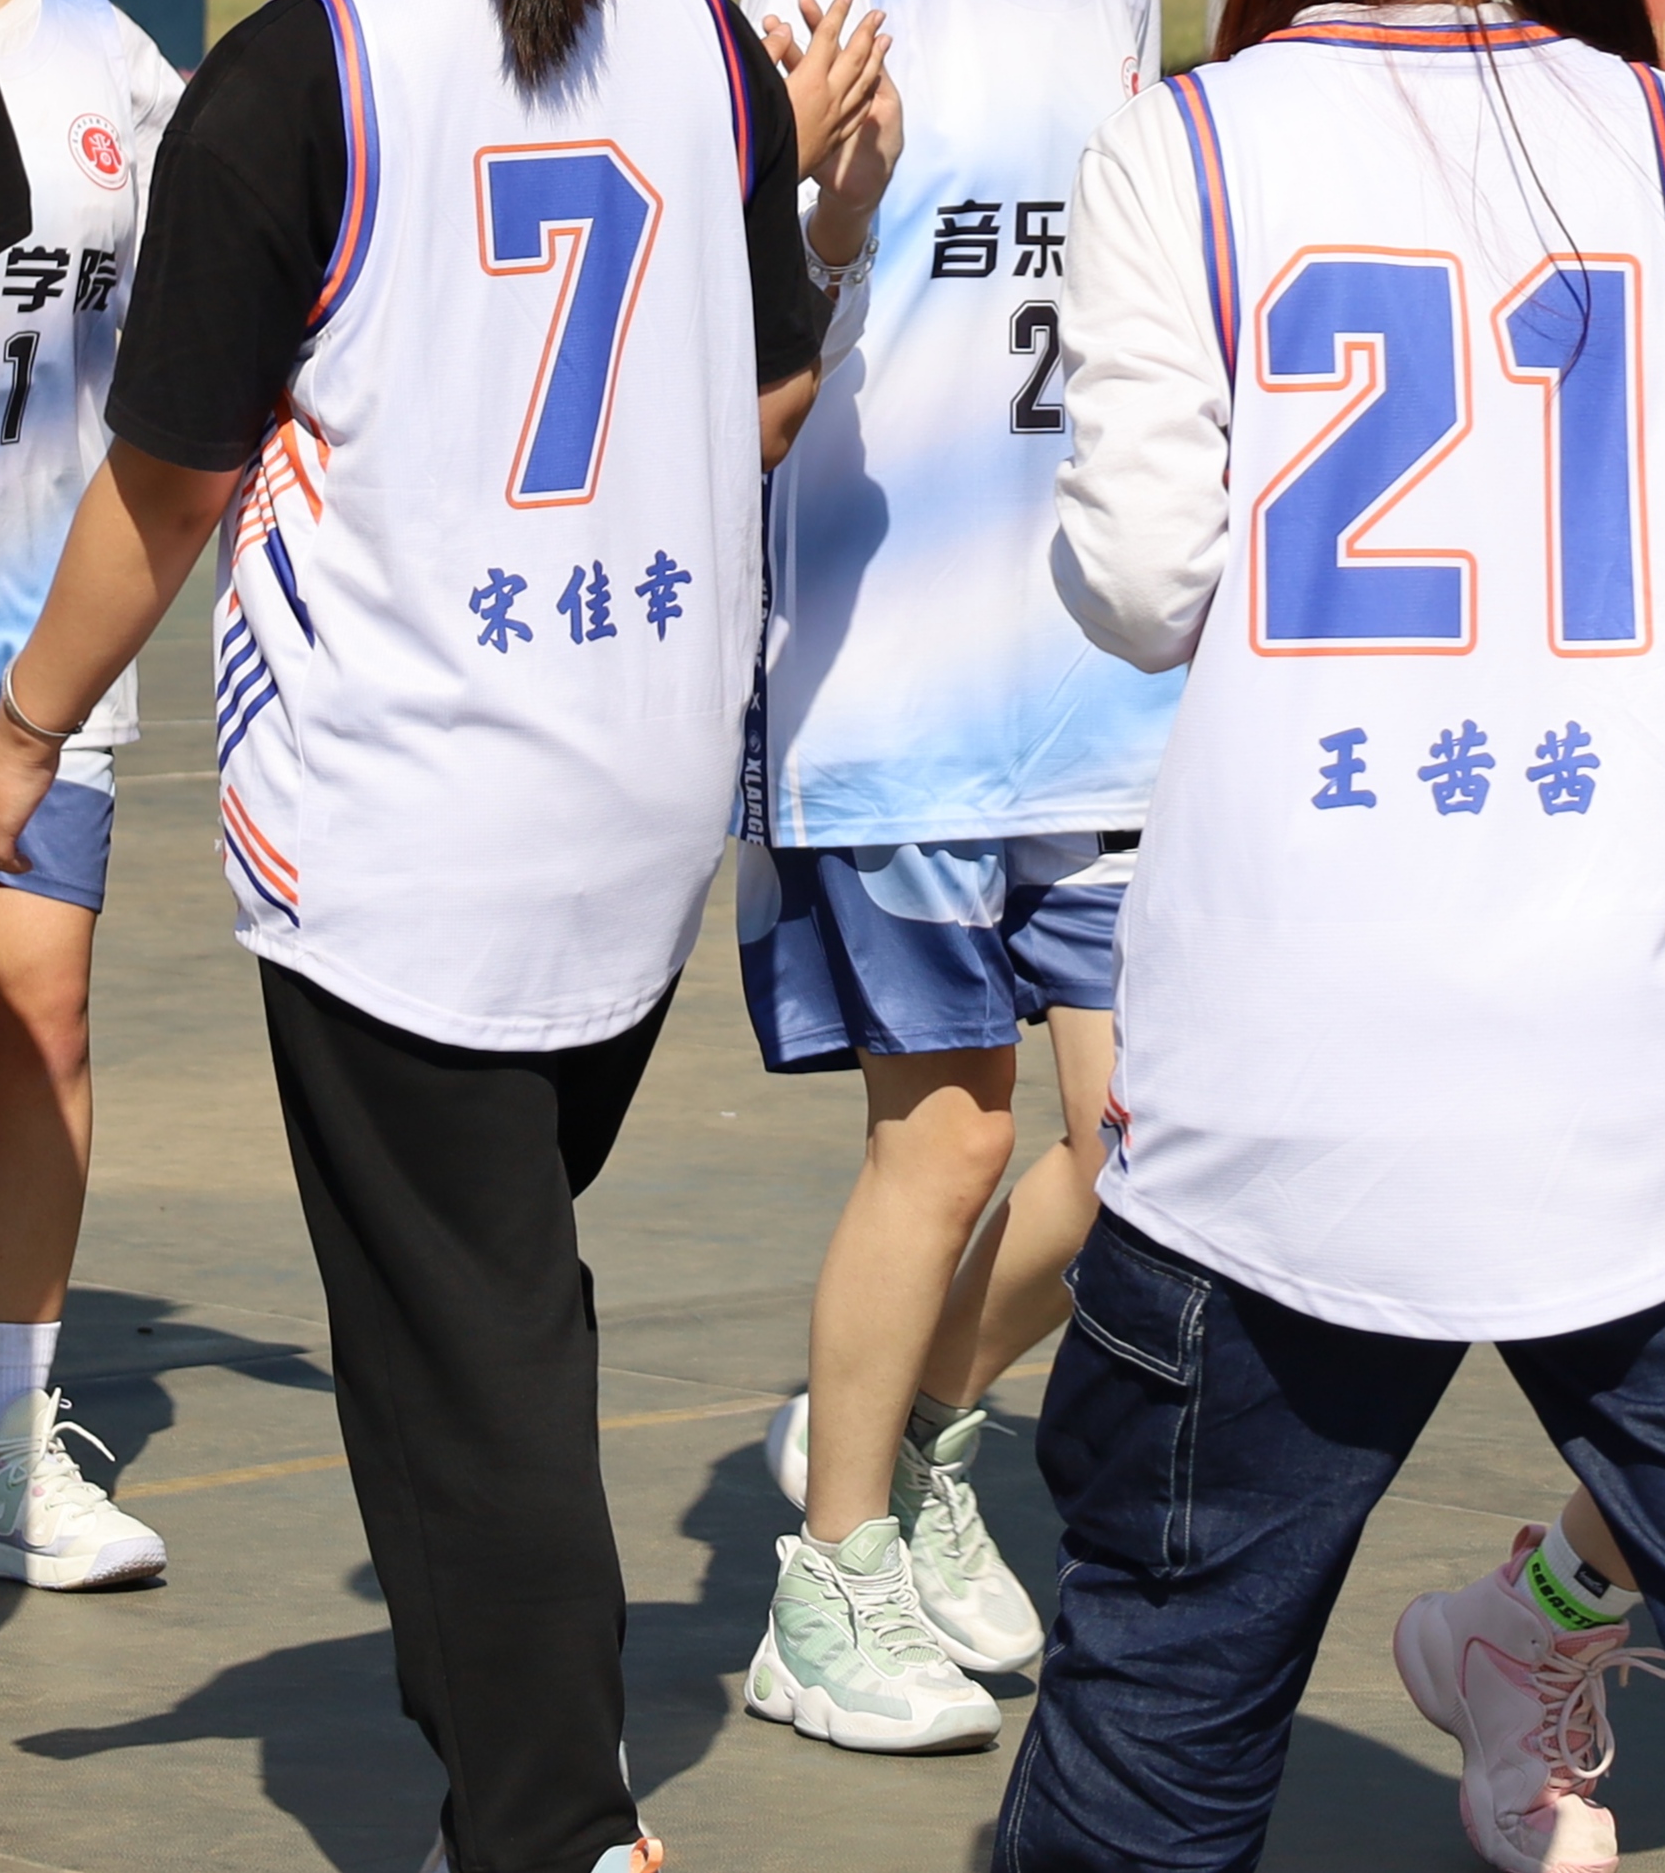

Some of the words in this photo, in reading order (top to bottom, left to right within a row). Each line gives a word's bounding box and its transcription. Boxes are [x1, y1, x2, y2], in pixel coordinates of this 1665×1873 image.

[473, 139, 664, 510] 7
[1249, 244, 1653, 658] 21
[1311, 718, 1601, 816] 王茜茜
